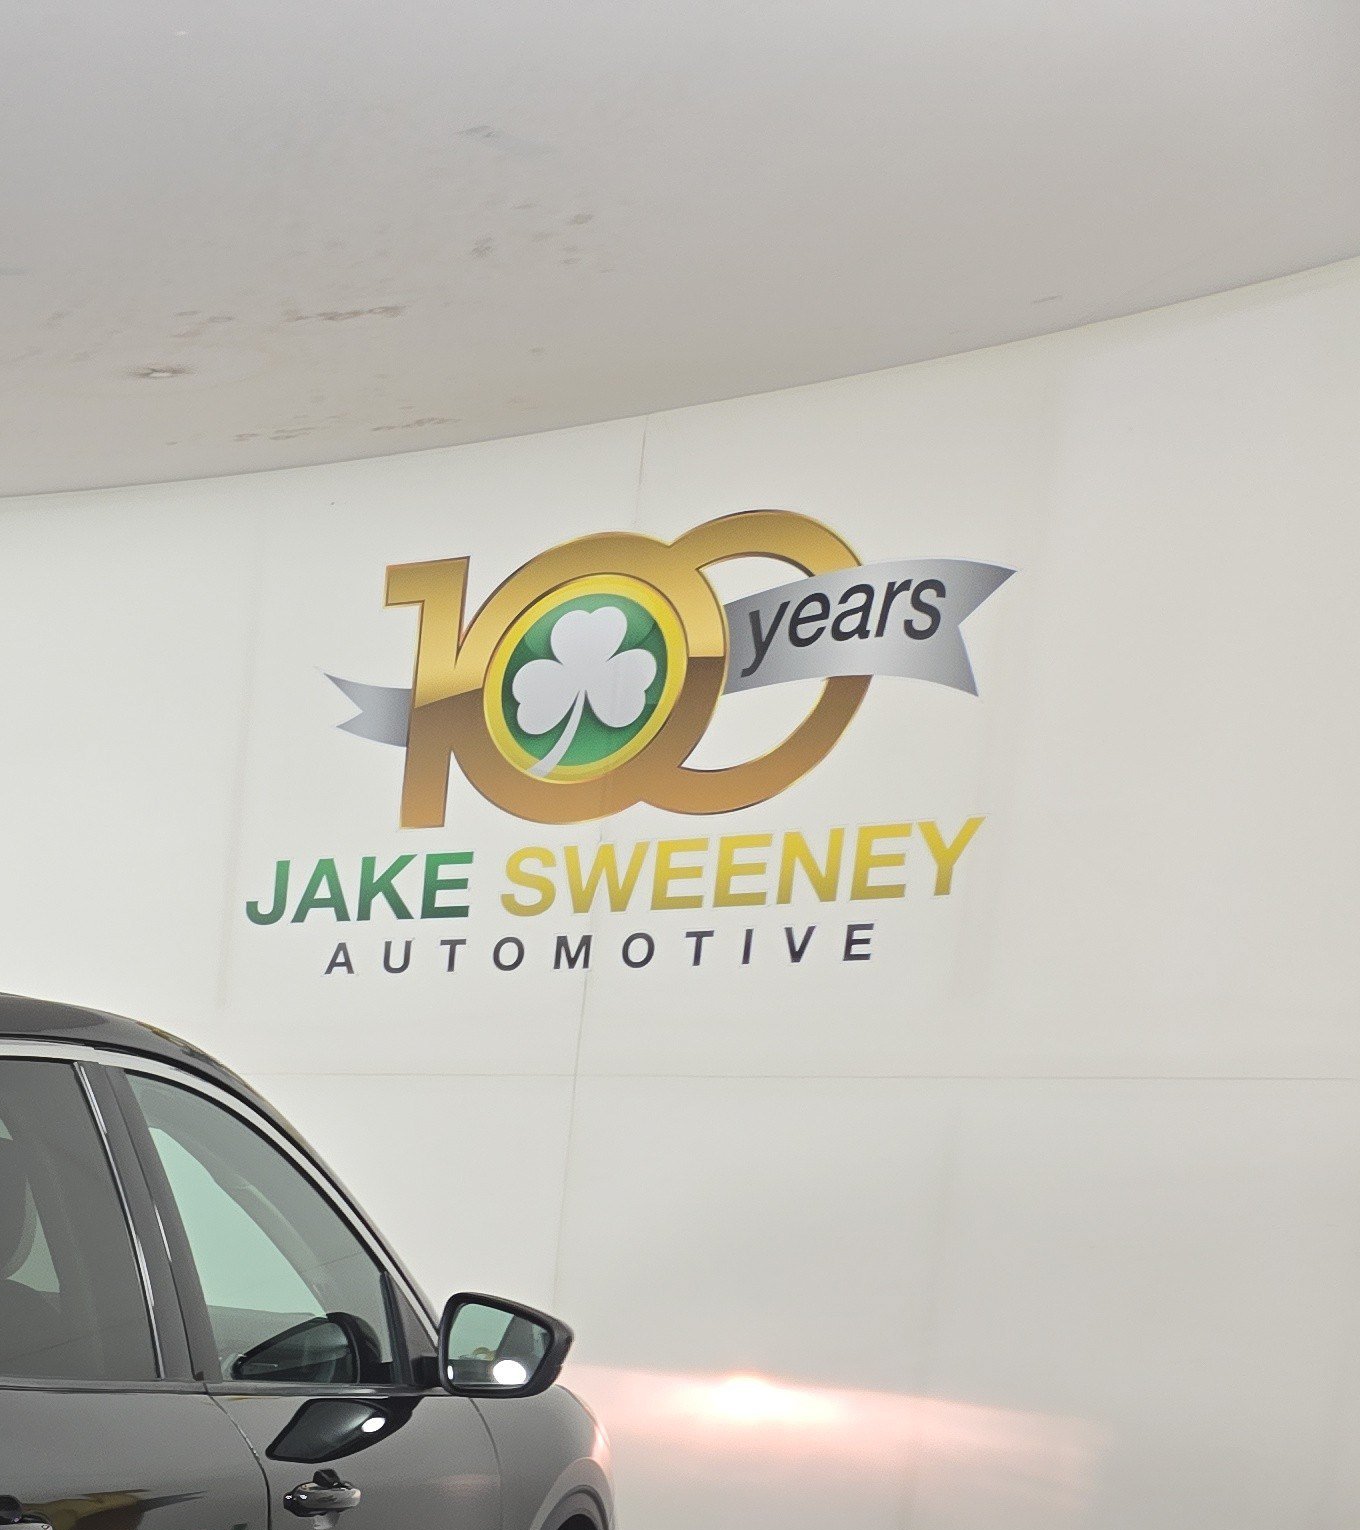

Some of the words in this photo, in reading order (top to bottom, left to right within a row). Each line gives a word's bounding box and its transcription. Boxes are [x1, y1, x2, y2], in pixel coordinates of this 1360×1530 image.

[384, 508, 874, 830] 100
[740, 577, 948, 679] years
[245, 850, 474, 927] JAKE
[499, 815, 987, 918] SWEENEY
[324, 922, 876, 976] AUTOMOTIVE
